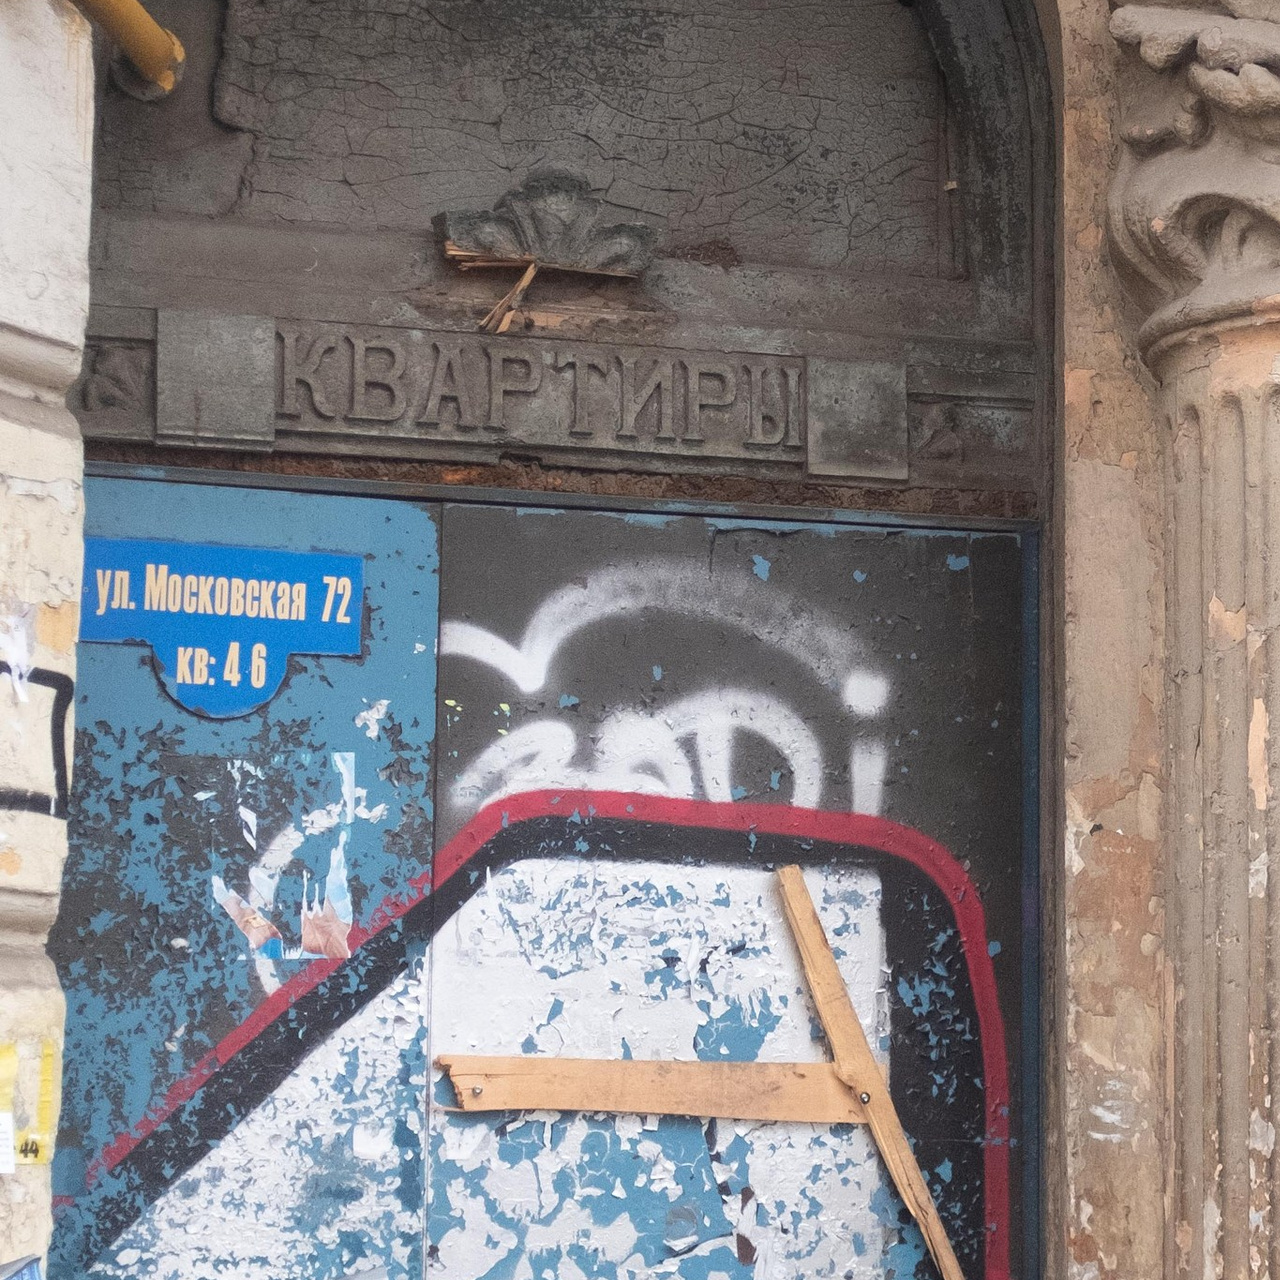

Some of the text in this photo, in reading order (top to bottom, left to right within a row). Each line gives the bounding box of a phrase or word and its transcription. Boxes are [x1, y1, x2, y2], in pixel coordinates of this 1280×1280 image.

[274, 326, 804, 450] КВАРТИРЫ
[96, 564, 352, 624] ул. Московская 72
[176, 646, 215, 686] кв:
